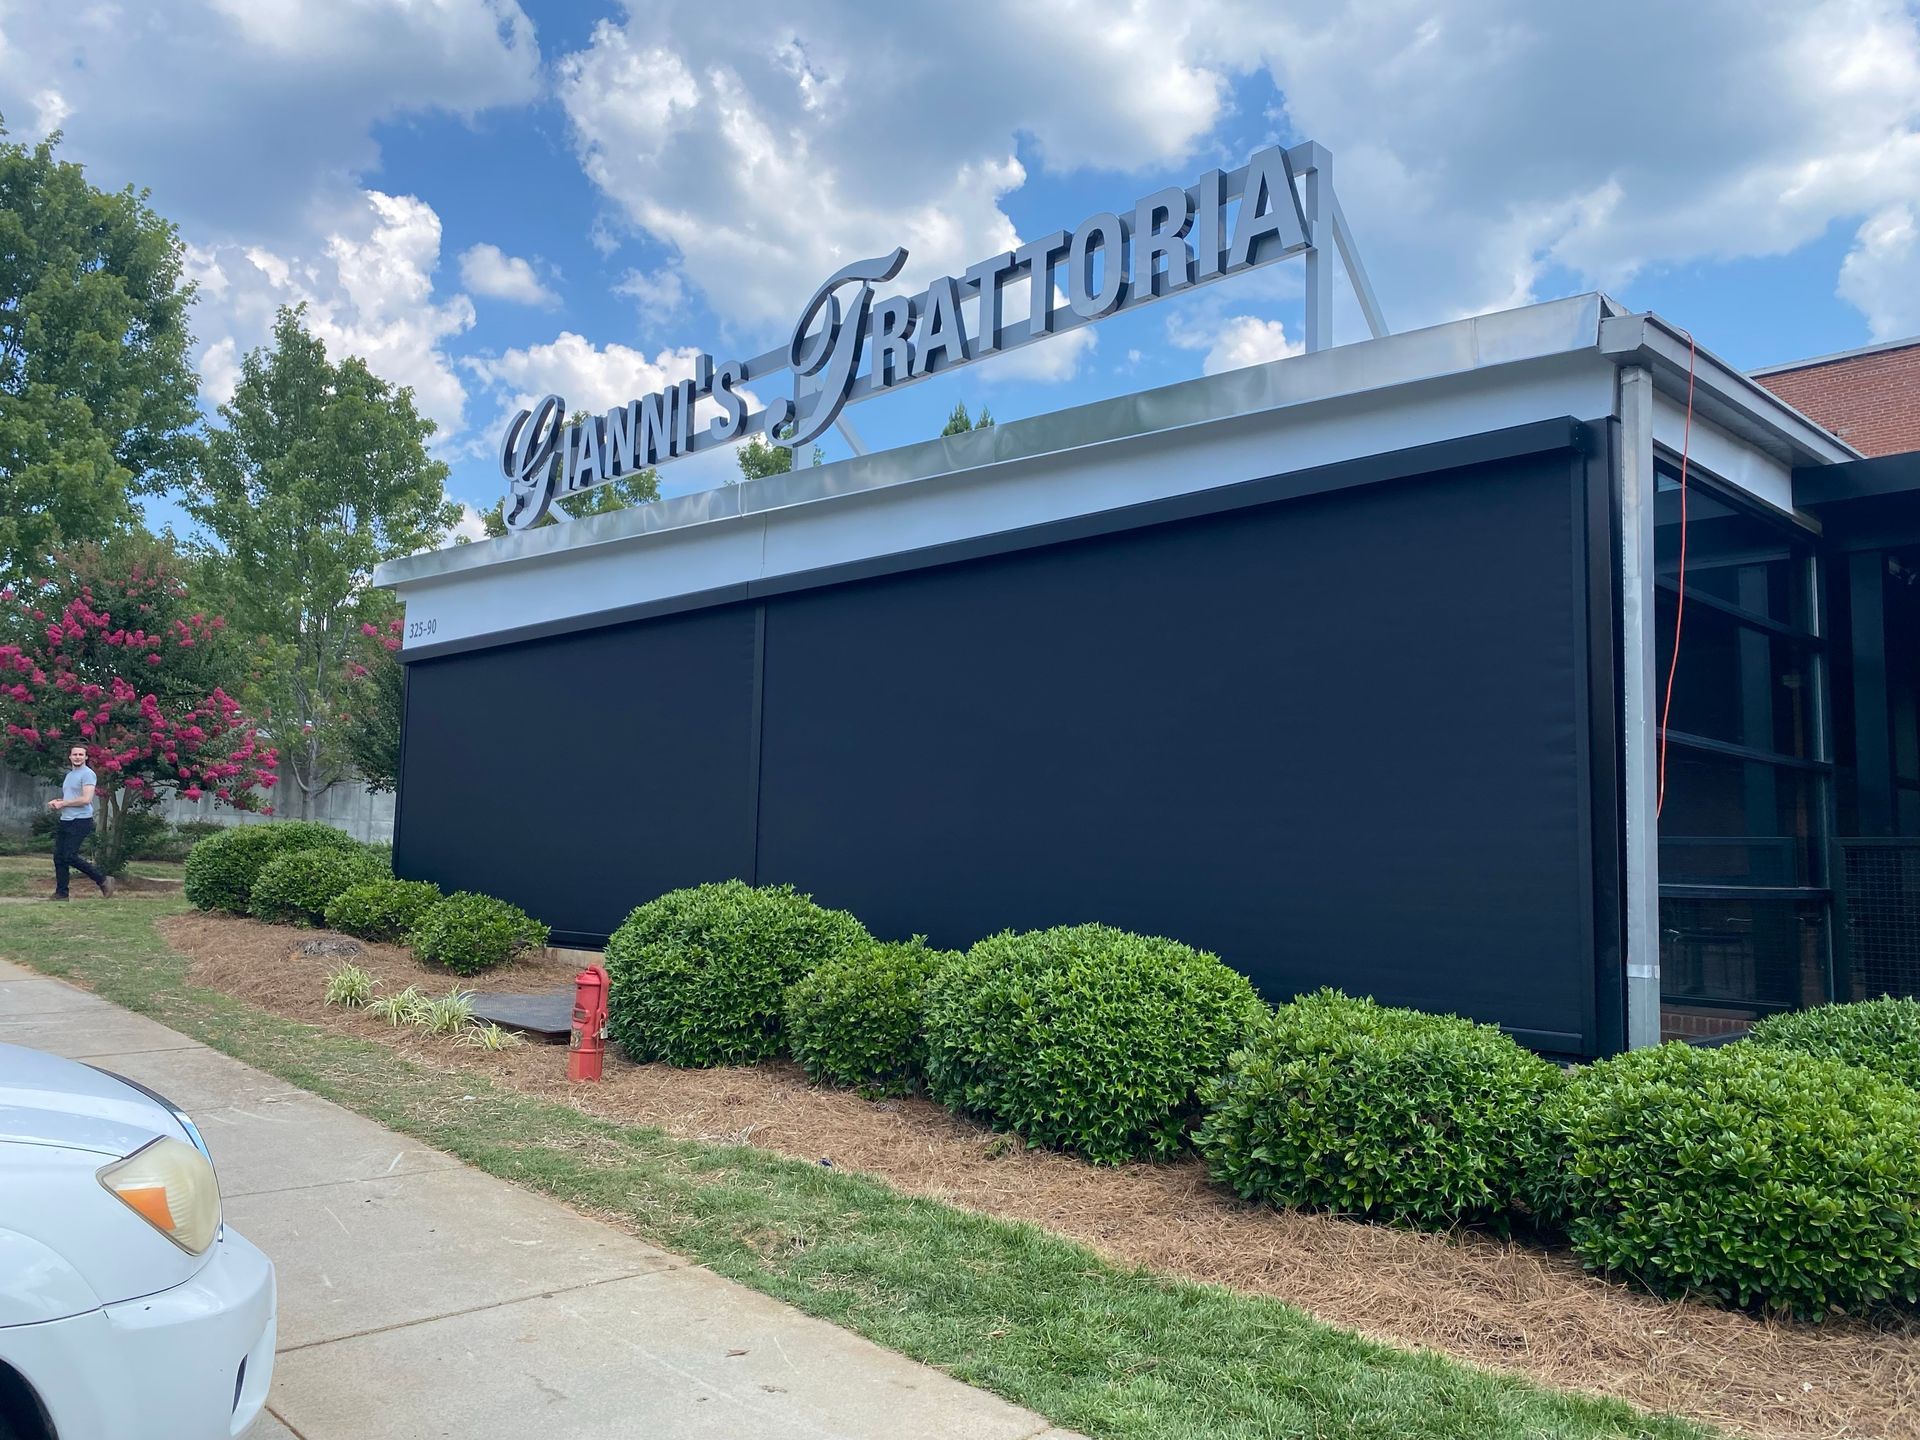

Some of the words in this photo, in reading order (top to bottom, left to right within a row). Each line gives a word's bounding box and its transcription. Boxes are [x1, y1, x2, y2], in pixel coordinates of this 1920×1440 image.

[501, 354, 748, 531] GIANNI'S
[765, 145, 1312, 448] TRATTORIA
[409, 618, 437, 639] 325-90
